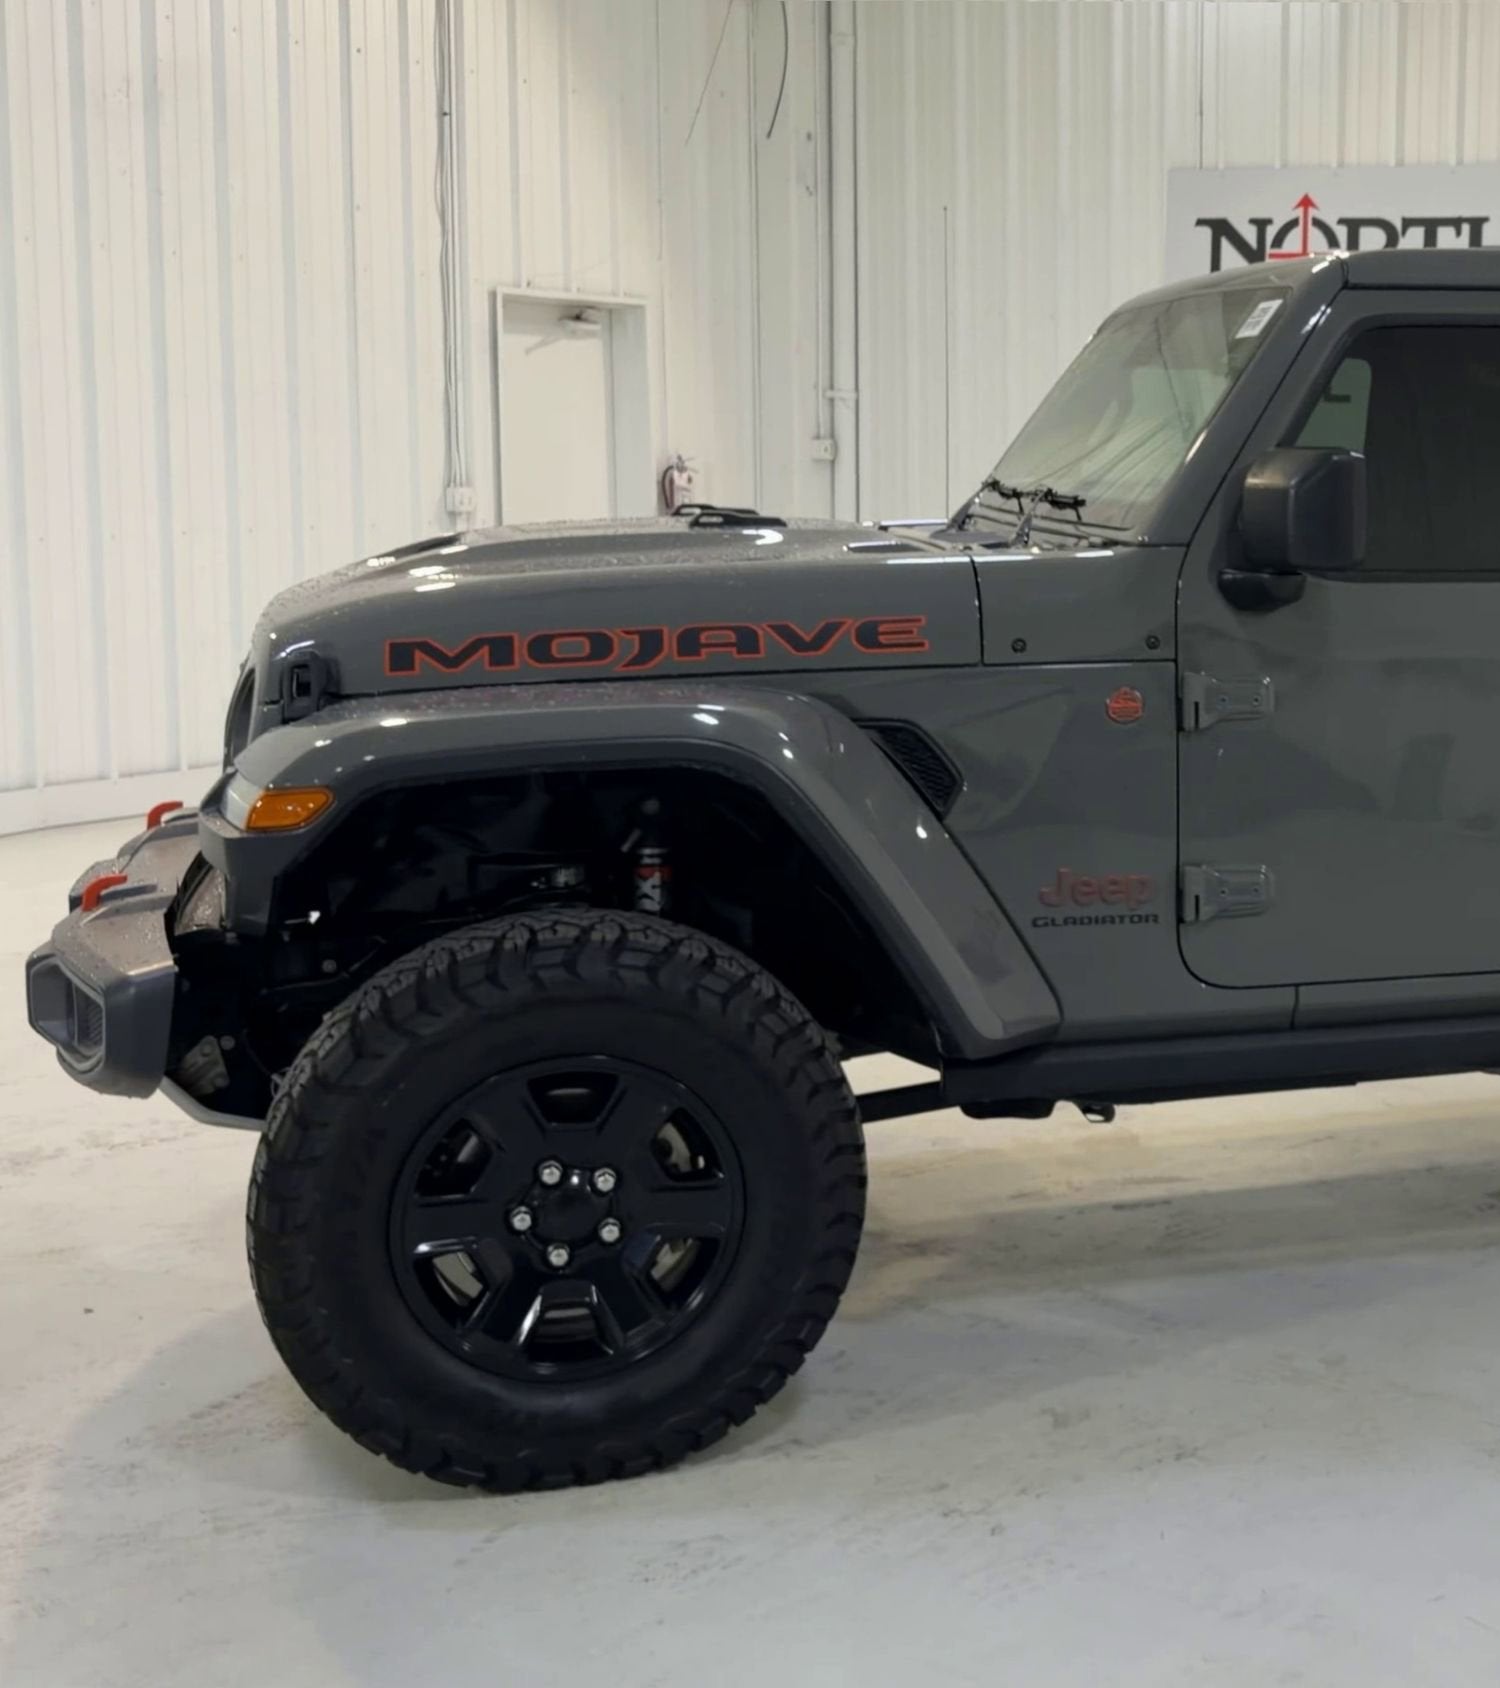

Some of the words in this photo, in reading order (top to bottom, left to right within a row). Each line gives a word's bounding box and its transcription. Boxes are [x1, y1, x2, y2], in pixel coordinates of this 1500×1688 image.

[384, 616, 929, 676] MOJAVE
[1039, 867, 1153, 910] Jeep
[1031, 914, 1160, 929] GLADIATOR
